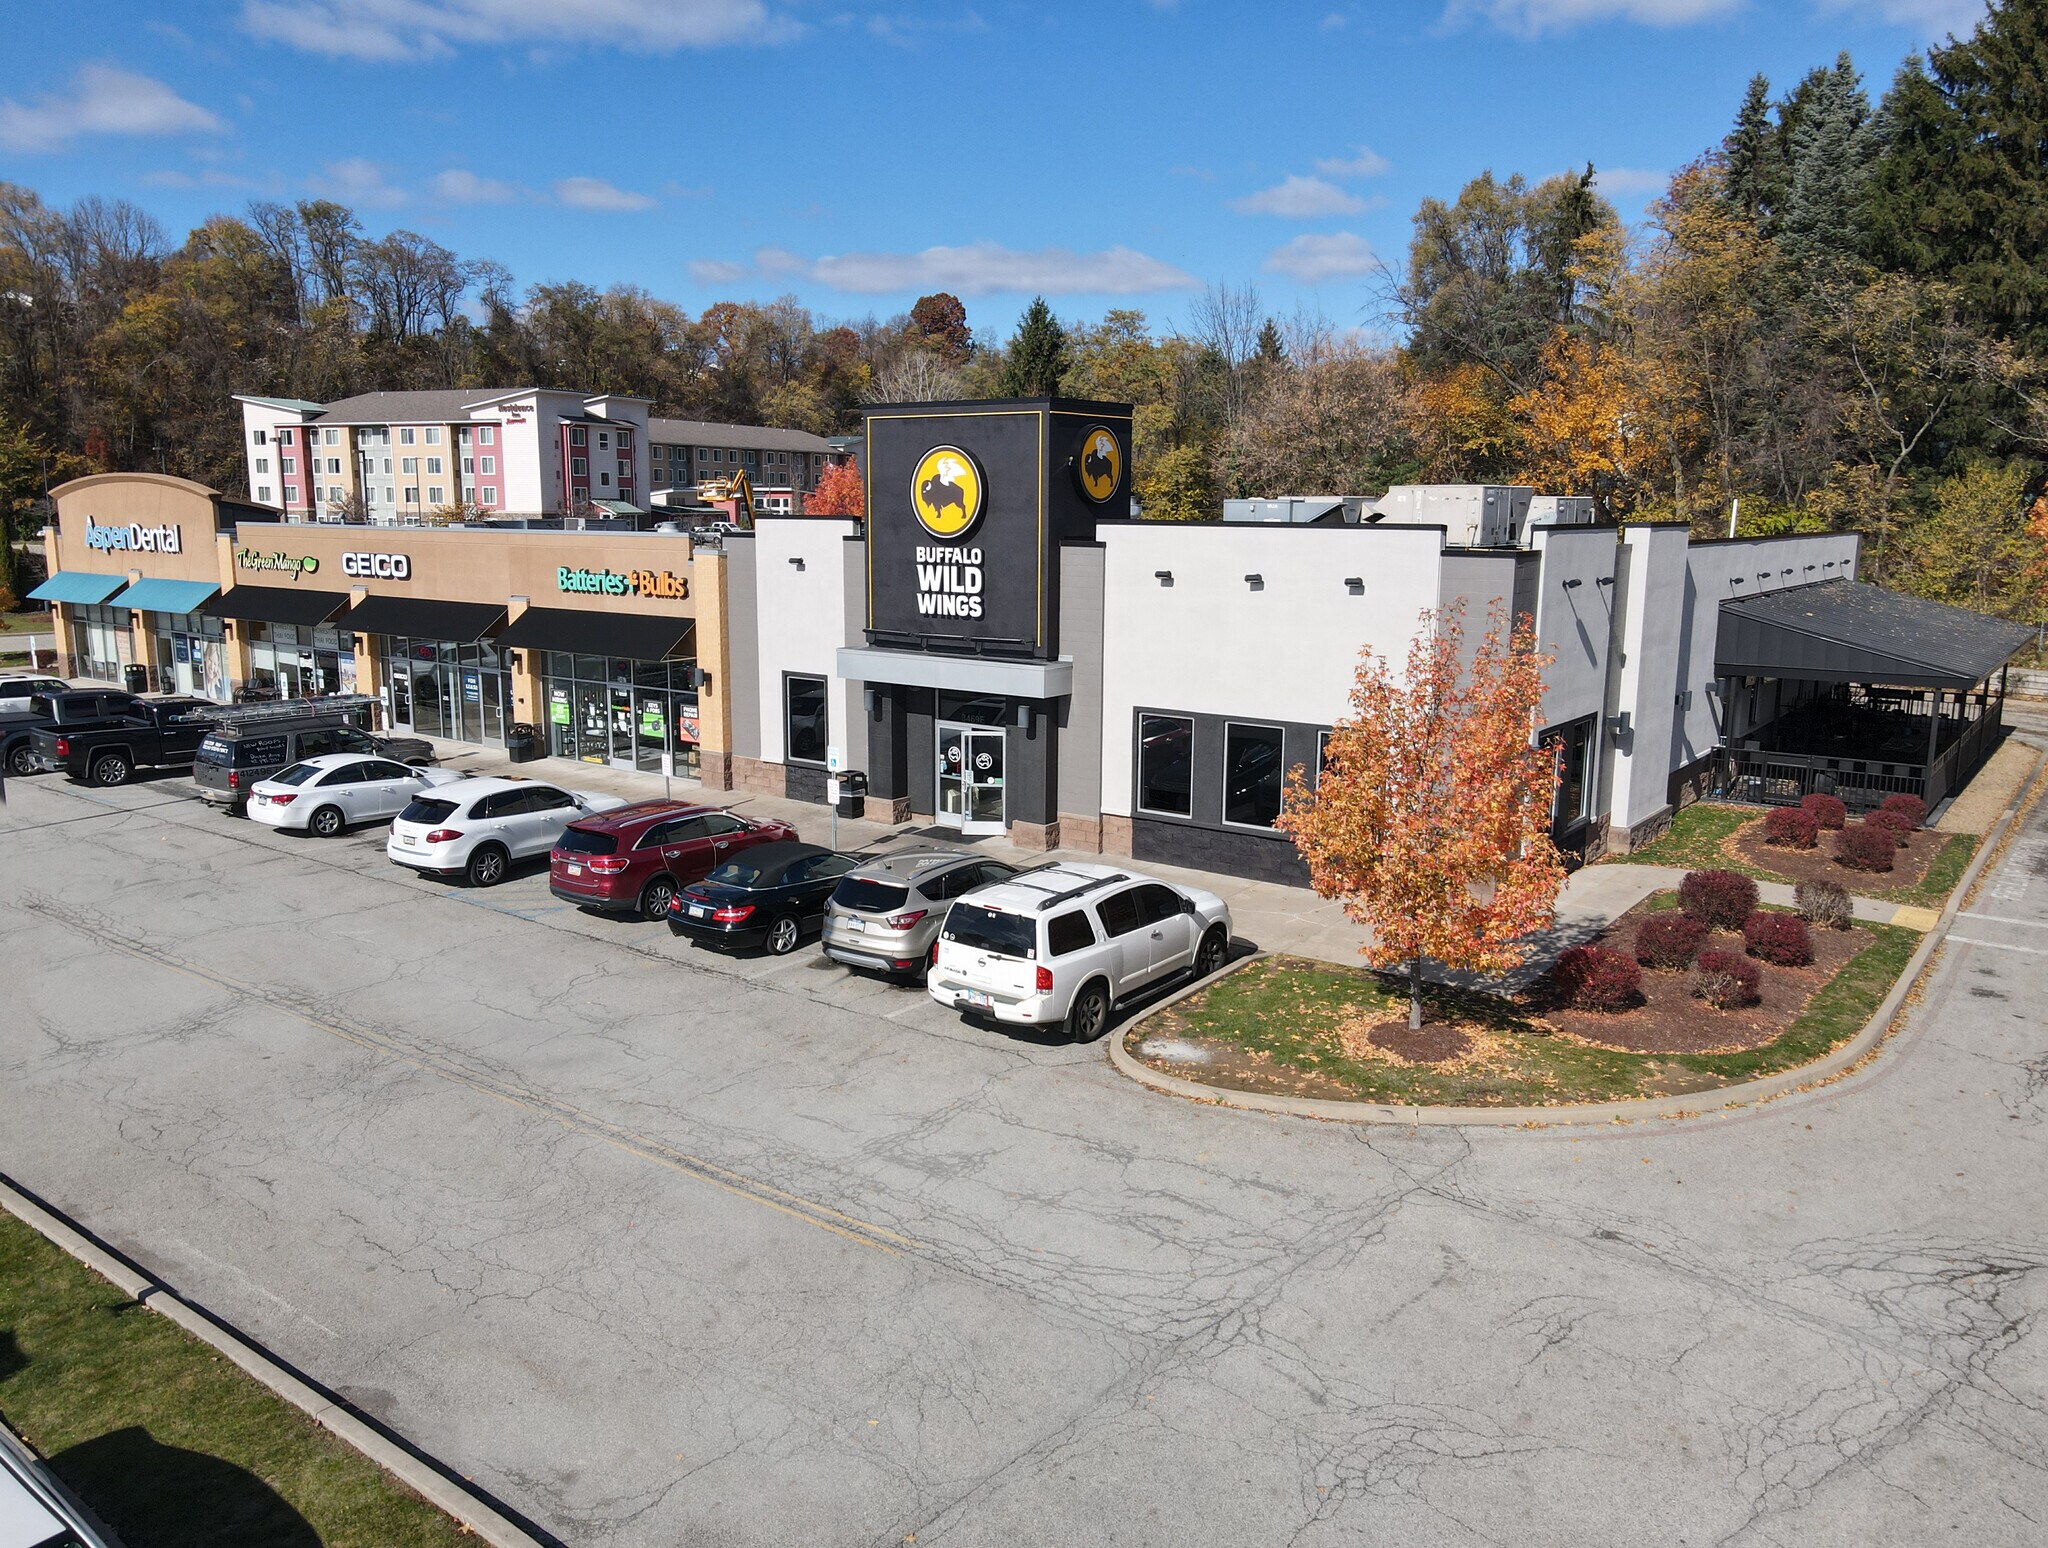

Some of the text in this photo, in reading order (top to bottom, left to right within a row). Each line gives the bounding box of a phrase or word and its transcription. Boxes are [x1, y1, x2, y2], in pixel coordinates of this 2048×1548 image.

[341, 552, 409, 578] GEICO
[916, 546, 982, 565] BUFFALO
[916, 564, 982, 594] WILD
[916, 593, 983, 618] WINGS
